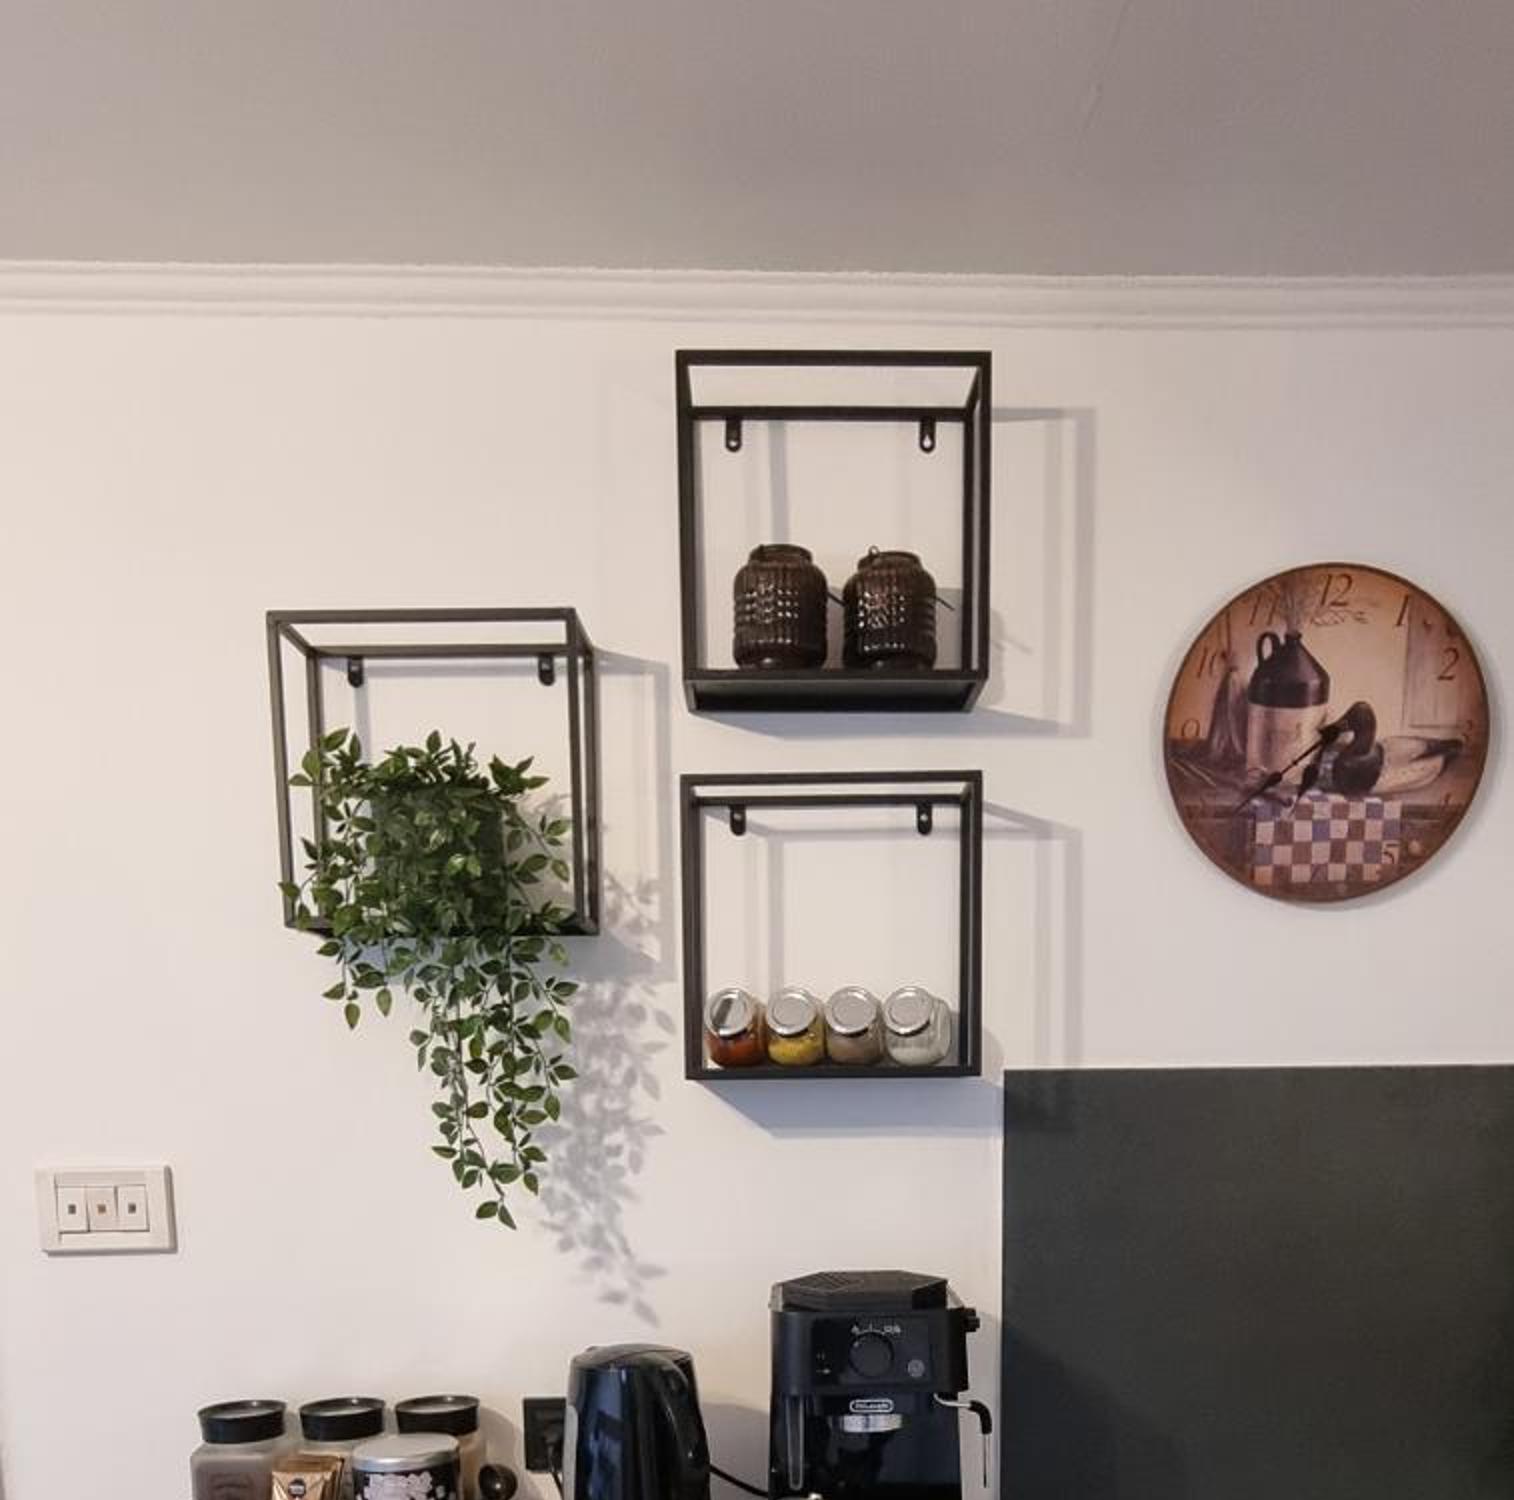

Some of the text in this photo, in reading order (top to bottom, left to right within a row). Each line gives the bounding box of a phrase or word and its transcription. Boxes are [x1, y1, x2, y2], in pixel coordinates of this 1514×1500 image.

[1320, 573, 1353, 607] 12
[1396, 594, 1409, 627] 1
[1437, 647, 1460, 681] 2
